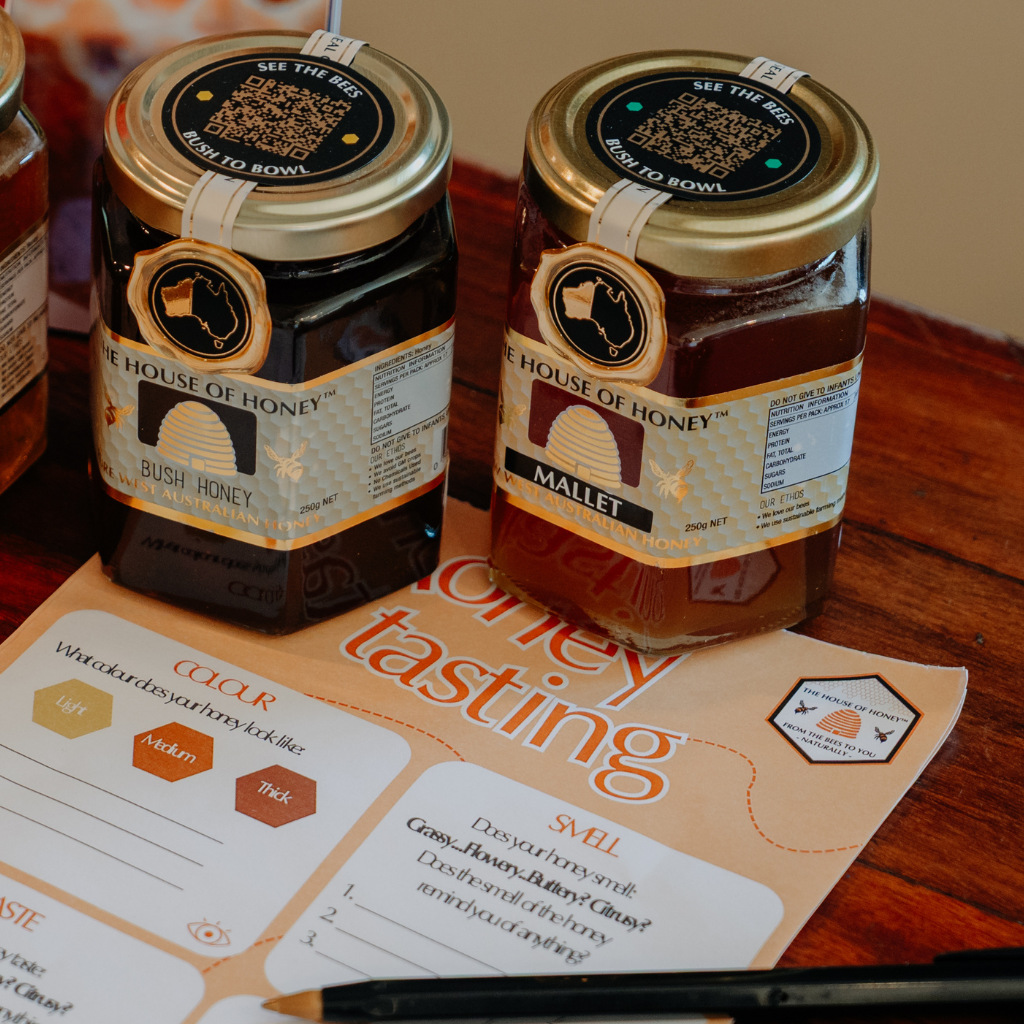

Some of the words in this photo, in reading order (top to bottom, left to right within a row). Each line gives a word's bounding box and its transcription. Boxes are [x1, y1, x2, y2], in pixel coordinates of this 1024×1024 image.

[257, 60, 288, 73] SEE
[293, 62, 329, 80] THE
[327, 74, 364, 100] BEES
[693, 80, 724, 93] SEE
[729, 84, 764, 104] THE
[761, 100, 795, 126] BEES
[182, 130, 220, 160] BUSH
[221, 155, 247, 171] TO
[250, 163, 311, 176] BOWL
[604, 137, 638, 169] BUSH
[638, 164, 664, 182] TO
[667, 176, 727, 193] BOWL
[125, 357, 199, 393] HOUSE
[205, 382, 235, 403] OF
[520, 354, 592, 398] HOUSE
[597, 387, 626, 410] OF
[770, 398, 781, 408] DO
[782, 395, 797, 404] NOT
[799, 390, 815, 400] GIVE
[816, 387, 826, 396] TO
[827, 377, 855, 392] INFANTS
[770, 403, 805, 418] NUTRITION
[807, 390, 849, 409] INFORMATION
[767, 437, 790, 449] PROTEIN
[769, 428, 790, 439] ENERGY
[765, 453, 807, 470] CARBOHYDRATE
[778, 447, 794, 457] TOTAL
[141, 459, 186, 489] BUSH
[197, 476, 253, 509] HONEY
[763, 479, 785, 490] SODIUM
[764, 469, 786, 480] SUGARS
[118, 472, 157, 496] WEST
[162, 487, 260, 527] AUSTRALIAN
[264, 513, 322, 531] HONEY
[300, 500, 321, 516] 250g
[322, 493, 339, 509] NET
[533, 465, 623, 518] MALLET
[760, 497, 775, 510] OUR
[780, 489, 805, 504] ETHOS
[504, 473, 541, 501] WEST
[545, 490, 638, 541] AUSTRALIAN
[641, 534, 703, 550] HONEY
[685, 520, 708, 533] 250g
[709, 517, 728, 529] NET
[55, 640, 93, 666] What
[91, 663, 138, 683] colour
[134, 678, 169, 699] does
[164, 692, 202, 712] your
[199, 702, 248, 732] honey
[244, 721, 280, 745] look
[173, 659, 276, 712] COLOUR
[803, 687, 821, 698] THE
[821, 693, 854, 708] HOUSE
[854, 704, 868, 712] OF
[55, 694, 88, 717] Light
[343, 608, 686, 801] tasting
[140, 733, 197, 764] Medium
[783, 721, 806, 735] FROM
[808, 729, 824, 740] THE
[824, 735, 843, 747] BEES
[844, 742, 856, 751] TO
[857, 747, 876, 758] YOU
[801, 737, 849, 757] NATURALLY
[256, 780, 293, 806] Thick
[471, 816, 512, 842] Does
[507, 836, 548, 858] your
[544, 848, 595, 882] honey
[548, 814, 620, 857] SMELL
[343, 883, 355, 900] 1.
[589, 898, 653, 933] Citrusy?
[299, 930, 317, 948] 3.
